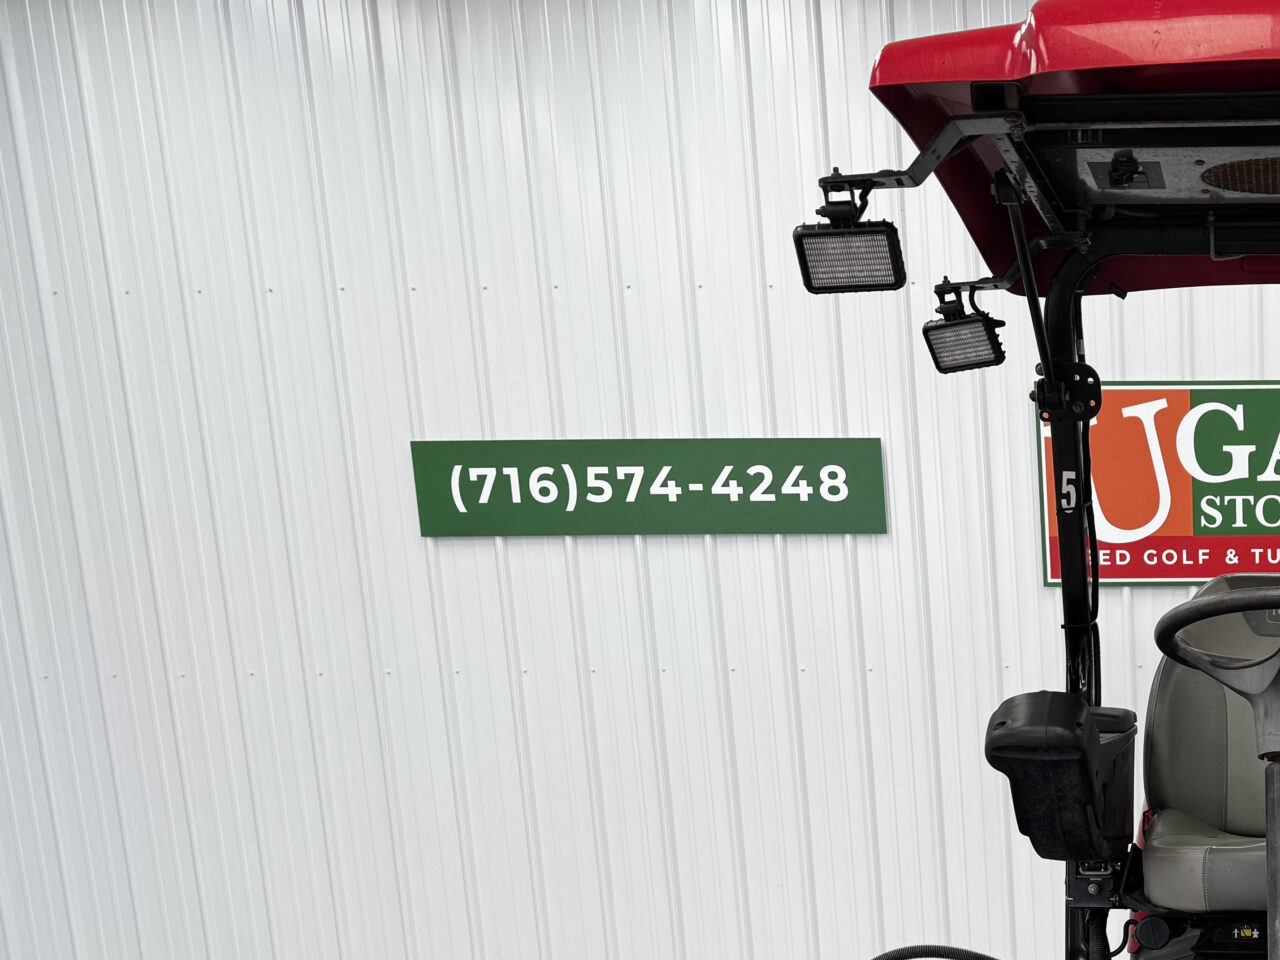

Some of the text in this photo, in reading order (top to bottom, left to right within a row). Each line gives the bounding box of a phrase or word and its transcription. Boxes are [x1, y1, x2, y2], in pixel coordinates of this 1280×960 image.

[450, 463, 850, 513] (716)574-4248
[1061, 470, 1077, 514] 5
[1088, 549, 1131, 566] ED
[1143, 549, 1210, 566] GOLF
[1224, 548, 1239, 565] &
